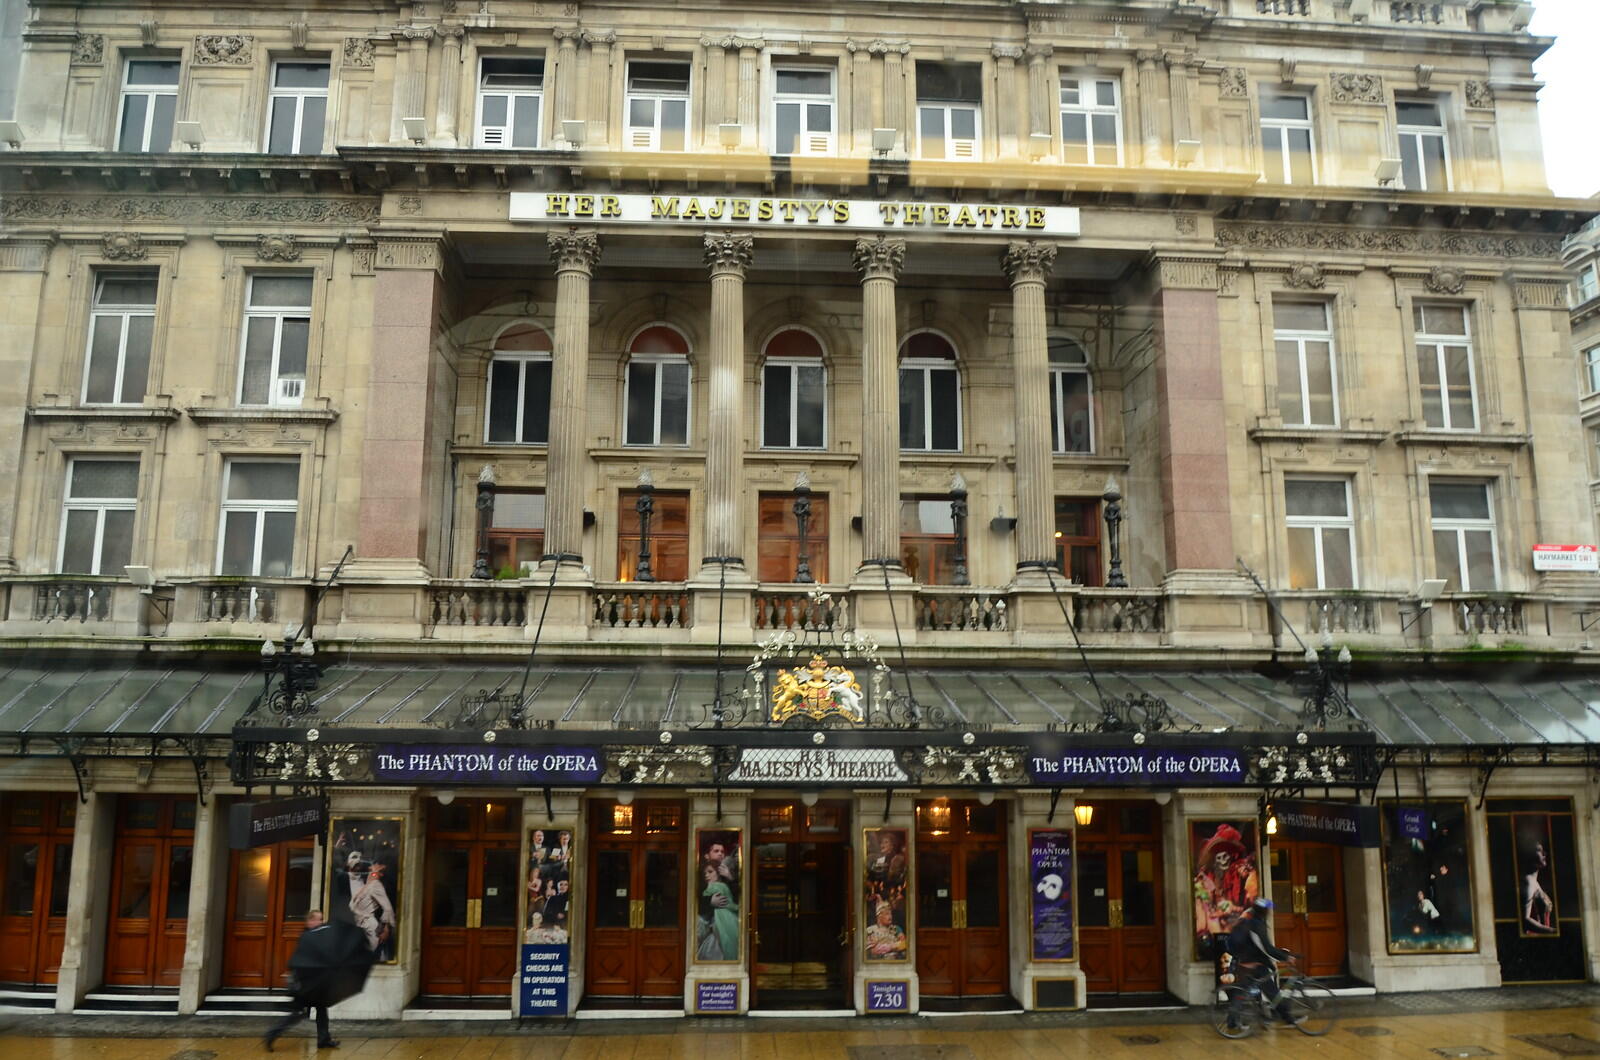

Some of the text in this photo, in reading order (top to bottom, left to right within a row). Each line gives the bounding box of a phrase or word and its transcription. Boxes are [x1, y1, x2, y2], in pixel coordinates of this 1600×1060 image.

[546, 194, 1046, 228] HER MAJESTY'S THEATRE
[1538, 553, 1577, 561] HAYMARKET
[378, 754, 598, 772] The PHANTOM of the OPERA
[801, 750, 836, 762] HER
[828, 762, 897, 778] THEATRE
[1033, 756, 1241, 773] The PHANTOM of the OPERA
[253, 820, 263, 832] The
[263, 812, 292, 832] PHANTOM
[304, 809, 320, 823] OPERA
[1288, 813, 1317, 829] PHANTOM
[1335, 817, 1356, 833] OPERA
[1032, 848, 1070, 856] PHANTOM
[1037, 860, 1063, 868] OPERA
[532, 976, 566, 984] OPERATION
[532, 988, 556, 996] AT THIS
[874, 993, 902, 1008] 7.30
